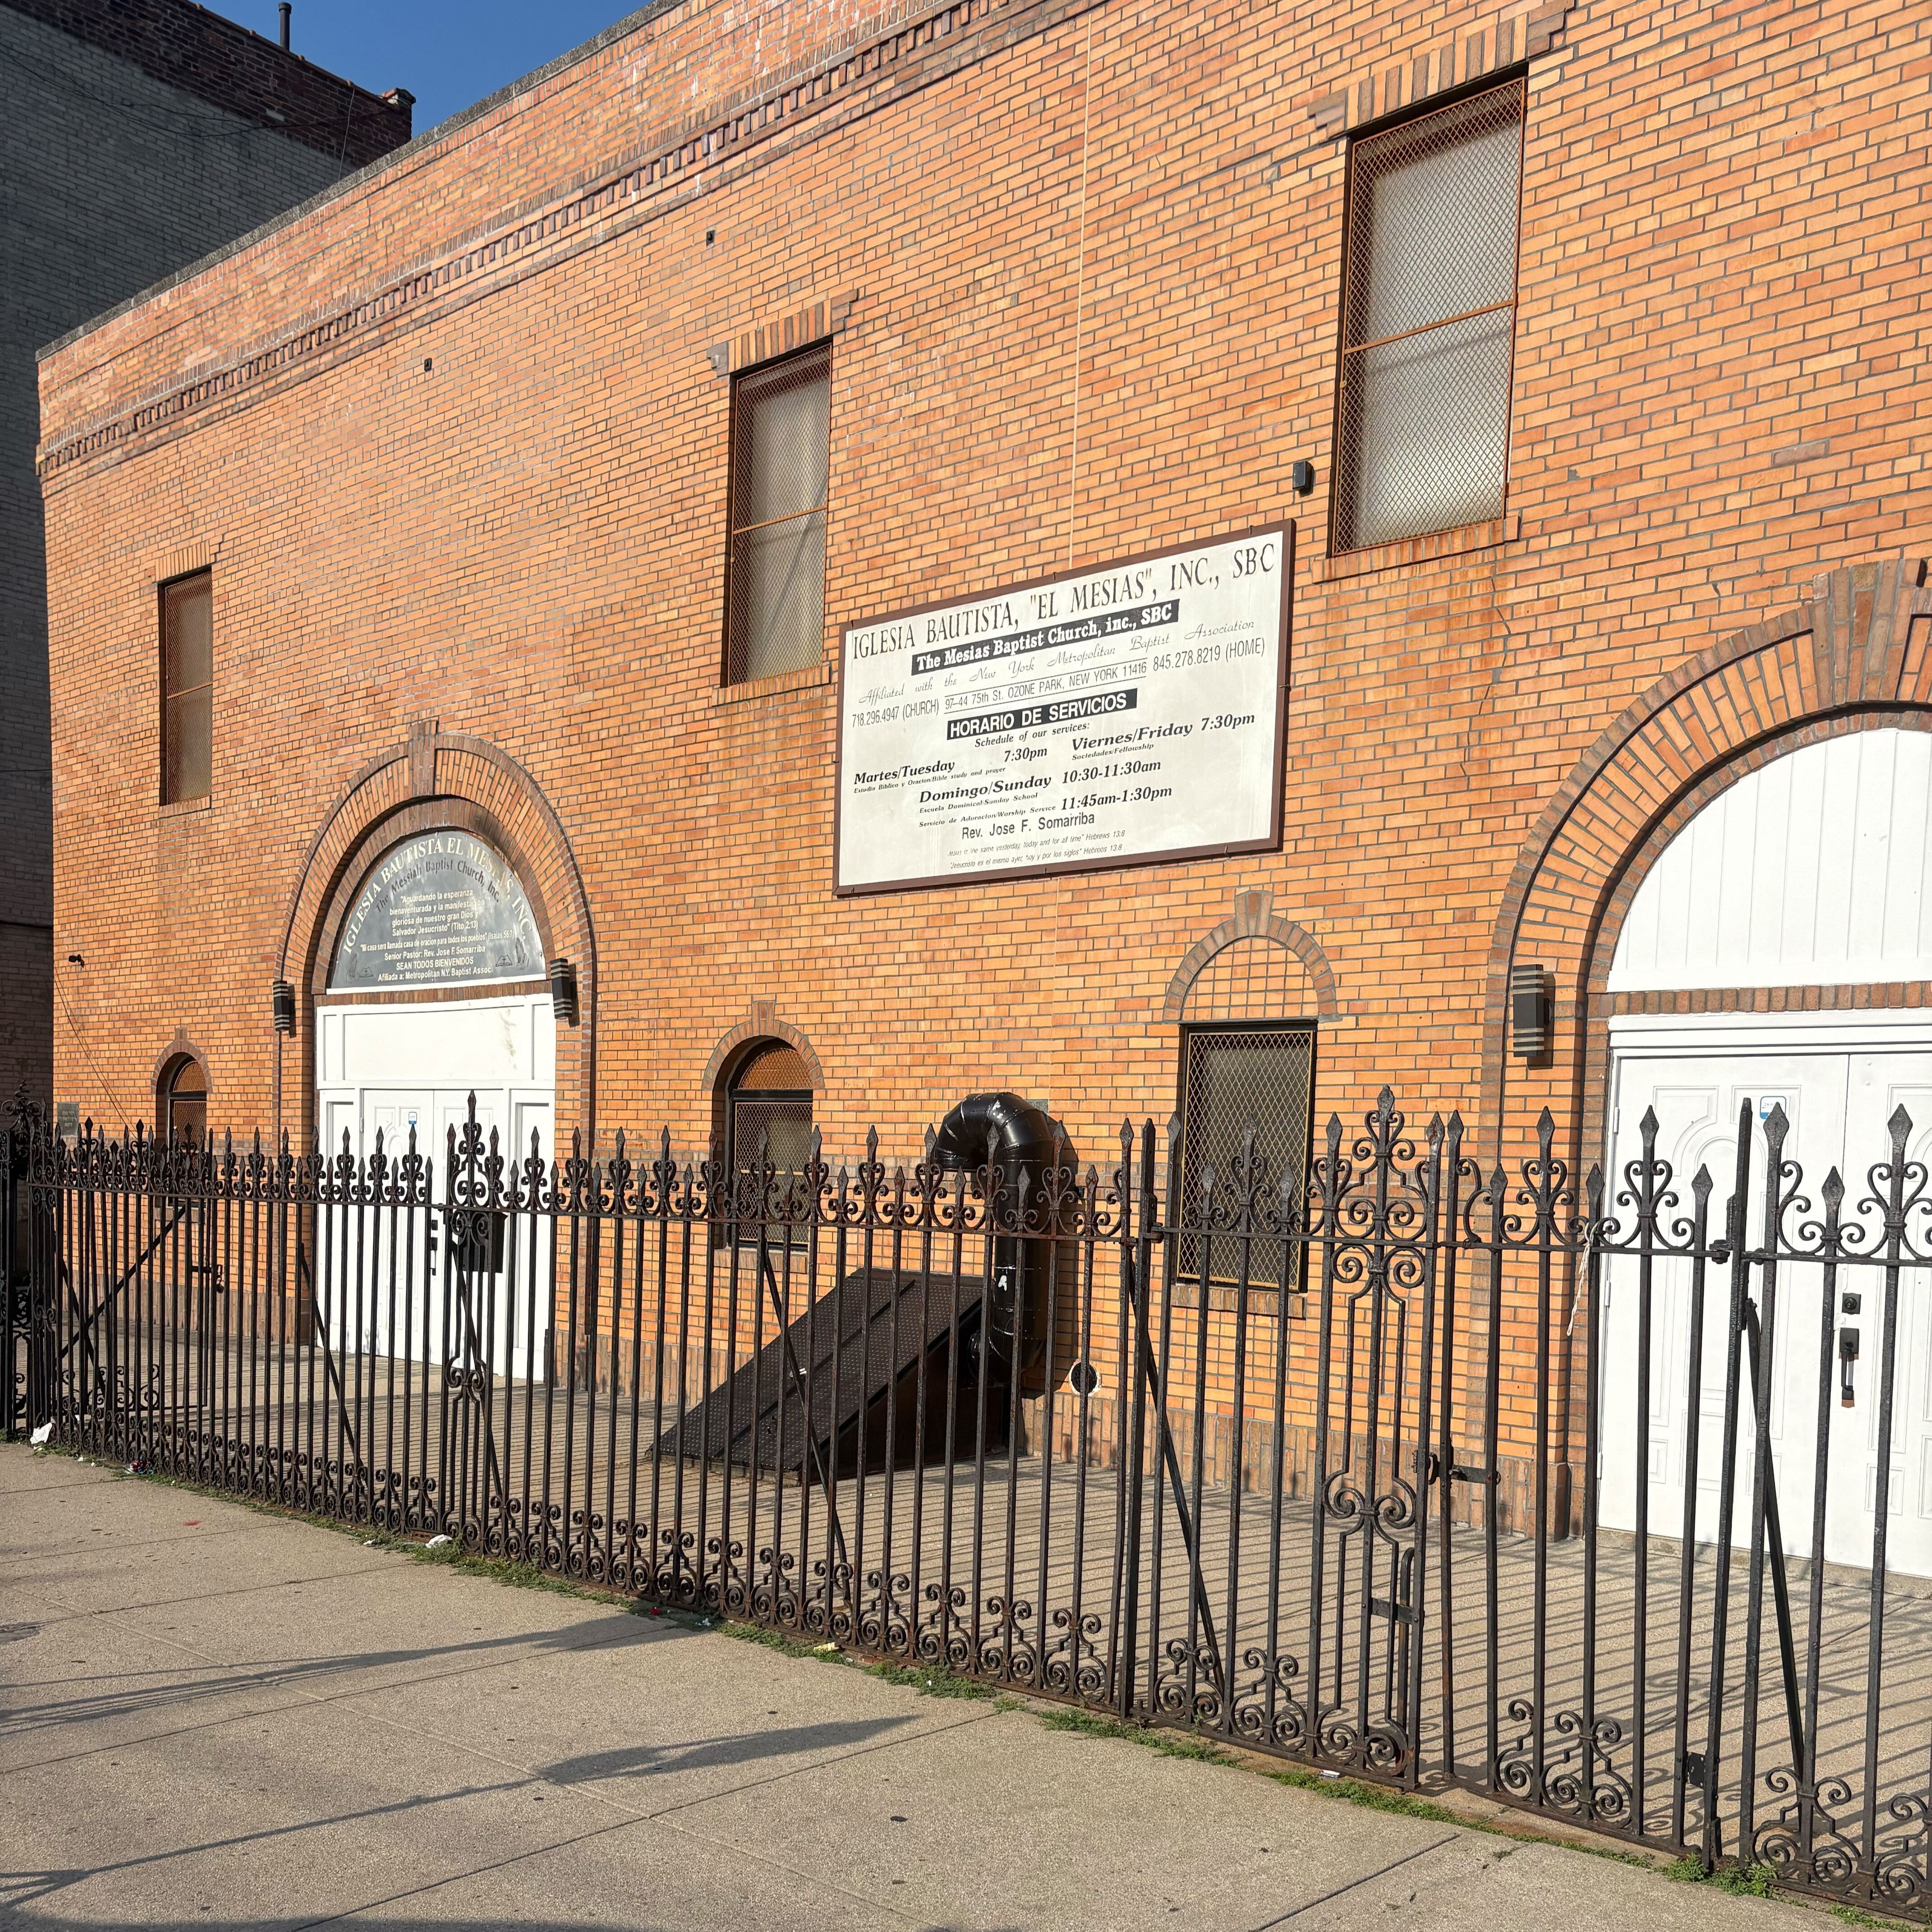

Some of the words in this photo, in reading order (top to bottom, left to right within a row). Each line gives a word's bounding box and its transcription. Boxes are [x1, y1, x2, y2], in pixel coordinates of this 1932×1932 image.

[853, 623, 915, 659] IGLESIA
[926, 601, 1018, 644] BAUTISTA,
[1030, 591, 1058, 620] "EL
[1070, 567, 1157, 613] MESIAS",
[1170, 557, 1219, 591] INC.,
[1233, 543, 1274, 579] SBC
[916, 653, 941, 671] The
[943, 644, 991, 666] Mesias
[992, 630, 1045, 656] Baptist
[1047, 618, 1102, 644] Church,
[1103, 616, 1136, 633] inc.,
[1138, 603, 1172, 626] SBC
[858, 682, 905, 706] Affiliated
[915, 676, 933, 692] with
[944, 672, 957, 687] the
[969, 666, 996, 682] New
[1008, 656, 1035, 679] York
[1047, 643, 1115, 667] Metropolitan
[1129, 633, 1169, 653] Baptist
[1184, 620, 1254, 640] Association
[1153, 644, 1221, 672] 845.278.8219
[1225, 637, 1265, 663] (HOME)
[971, 692, 989, 704] 75th
[992, 689, 1003, 701] St.
[1007, 682, 1035, 698] OZONE
[1039, 677, 1064, 693] PARK,
[1069, 672, 1090, 687] NEW
[1094, 667, 1118, 682] YORK
[1122, 661, 1146, 677] 11416
[852, 705, 899, 728] 718.296.4947
[902, 698, 939, 722] (CHURCH)
[950, 713, 1015, 738] HORARIO
[1021, 707, 1042, 726] DE
[1048, 692, 1127, 721] SERVICIOS
[974, 733, 1014, 748] Schedule
[1018, 730, 1029, 742] of
[1032, 730, 1047, 738] our
[1051, 722, 1090, 735] services:
[1072, 722, 1193, 751] Viernes/Friday
[1201, 713, 1255, 731] 7:30pm
[1072, 743, 1154, 760] Sociedades/Fellowship
[853, 760, 955, 785] Martes/Tuesday
[1004, 747, 1047, 762] 7:30pm
[907, 774, 948, 786] Oracion/Bible
[985, 767, 1006, 775] prayer
[919, 775, 1052, 803] Domingo/Sunday
[1062, 760, 1161, 784] 10:30-11:30am
[919, 805, 944, 814] Escuela
[948, 797, 1009, 810] Dominical/Sunday
[1012, 791, 1038, 801] School
[1061, 786, 1172, 810] 11:45am-1:30pm
[918, 819, 945, 828] Servicio
[960, 809, 1026, 822] Adoracion/Worship
[962, 827, 983, 840] Rev.
[989, 823, 1015, 836] Jose
[1021, 819, 1031, 833] F.
[1038, 811, 1095, 830] Somarriba
[1039, 838, 1051, 846] and
[1085, 833, 1110, 841] Hebrews
[1113, 829, 1126, 837] 13:8
[1041, 852, 1052, 860] por
[1063, 848, 1082, 858] siglos"
[1110, 843, 1122, 851] 13:8
[343, 883, 382, 954] IGLESIA
[381, 837, 442, 885] BAUTISTA
[447, 837, 464, 855] EL
[511, 896, 531, 939] INC.
[375, 894, 390, 914] The
[391, 864, 422, 896] Messiah
[426, 858, 453, 874] Baptist
[457, 860, 484, 888] Church,
[487, 880, 500, 902] Inc.
[400, 892, 436, 904] "Aguardando
[437, 891, 442, 900] la
[443, 889, 473, 900] esperanza
[389, 903, 432, 915] bienaventurada
[432, 905, 437, 913] y
[437, 902, 443, 911] la
[391, 917, 414, 928] gloriosa
[415, 915, 423, 924] de
[423, 914, 446, 923] nuestro
[446, 913, 460, 923] gran
[460, 910, 473, 919] Dios
[474, 912, 478, 921] y
[391, 927, 417, 936] Salvador
[417, 922, 450, 934] Jesucristo"
[451, 921, 465, 933] (Tito
[384, 952, 402, 961] Senior
[402, 950, 423, 959] Pastor:
[423, 948, 435, 957] Rev.
[436, 948, 450, 957] Jose
[455, 944, 485, 954] Somarriba
[414, 938, 420, 947] de
[437, 938, 447, 946] para
[447, 935, 460, 944] todos
[377, 972, 398, 982] Afiliada
[405, 969, 440, 980] Metropolitan
[451, 966, 471, 977] Baptist
[472, 966, 493, 975] Assoc.
[396, 961, 412, 971] SEAN
[413, 959, 434, 969] TODOS
[434, 956, 474, 967] BIENVENIDOS
